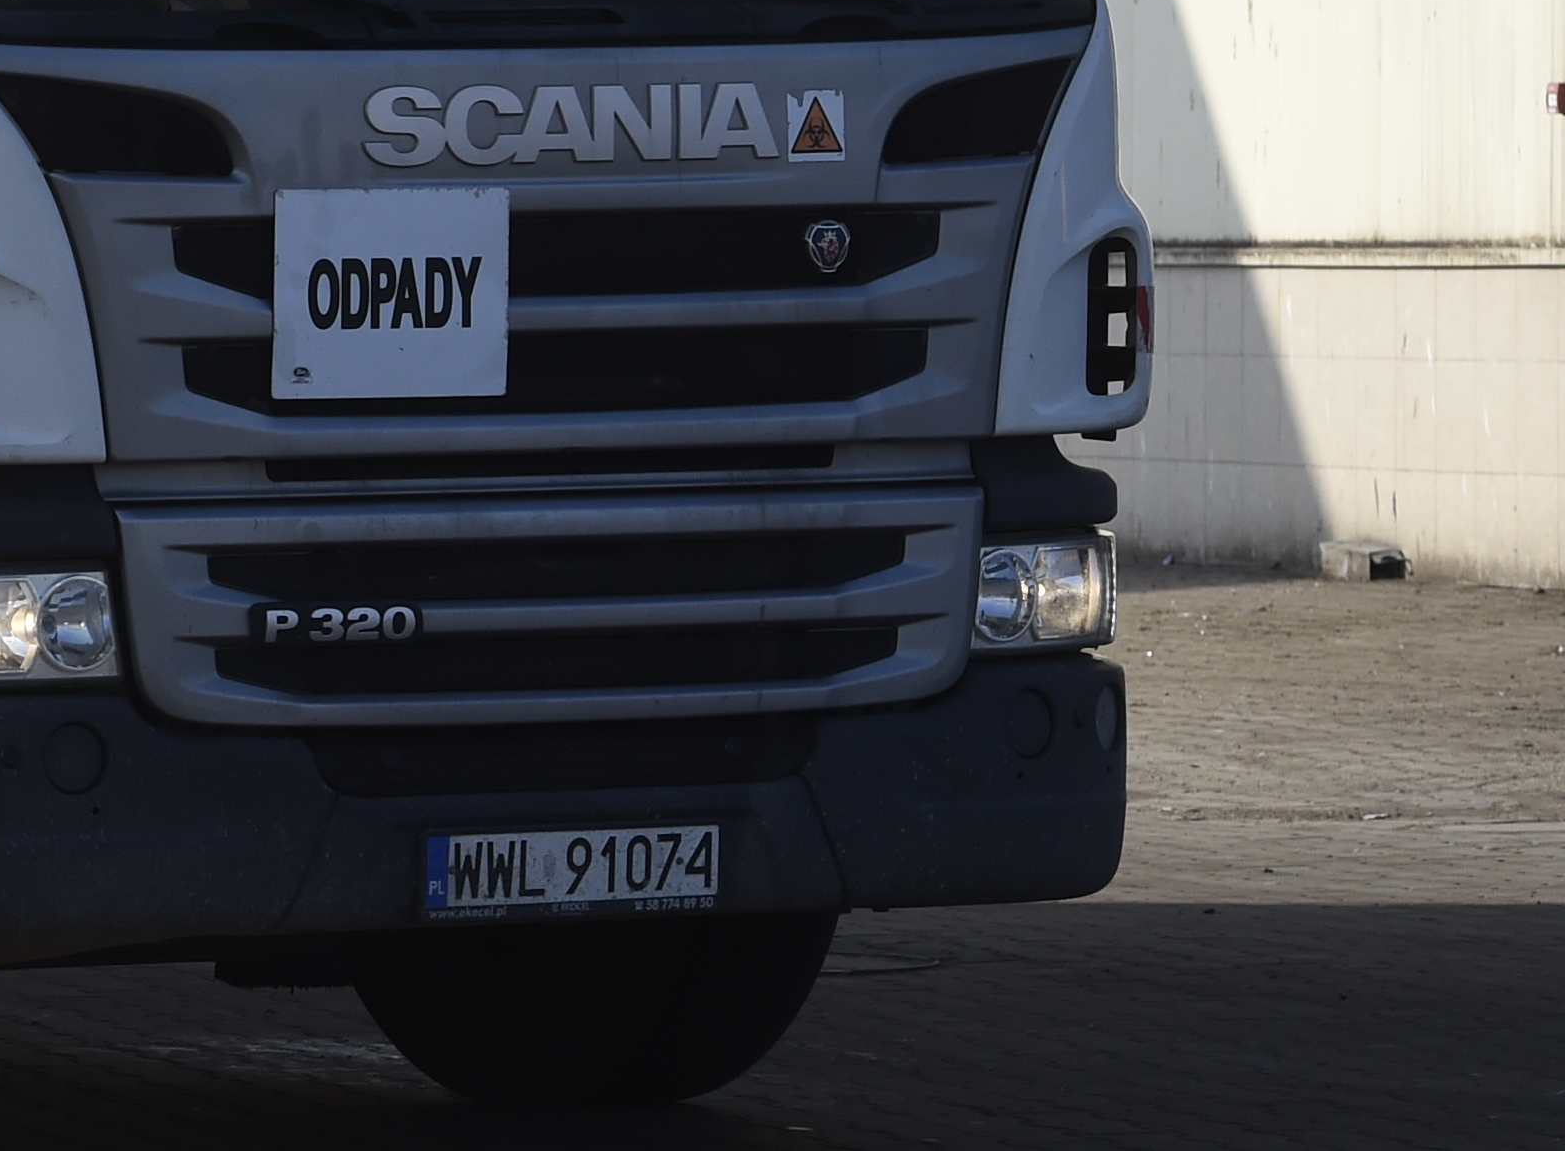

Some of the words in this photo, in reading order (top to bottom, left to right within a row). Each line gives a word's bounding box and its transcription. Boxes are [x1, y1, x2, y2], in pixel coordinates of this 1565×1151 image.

[363, 82, 780, 167] SCANIA
[307, 255, 483, 331] ODPADY
[265, 608, 299, 643] P
[309, 606, 416, 642] 320
[429, 880, 445, 896] PL
[454, 839, 545, 900] WWL
[565, 831, 713, 895] 91074
[645, 900, 659, 911] 58
[660, 899, 680, 910] 774
[683, 898, 698, 909] 89
[700, 897, 714, 909] 50
